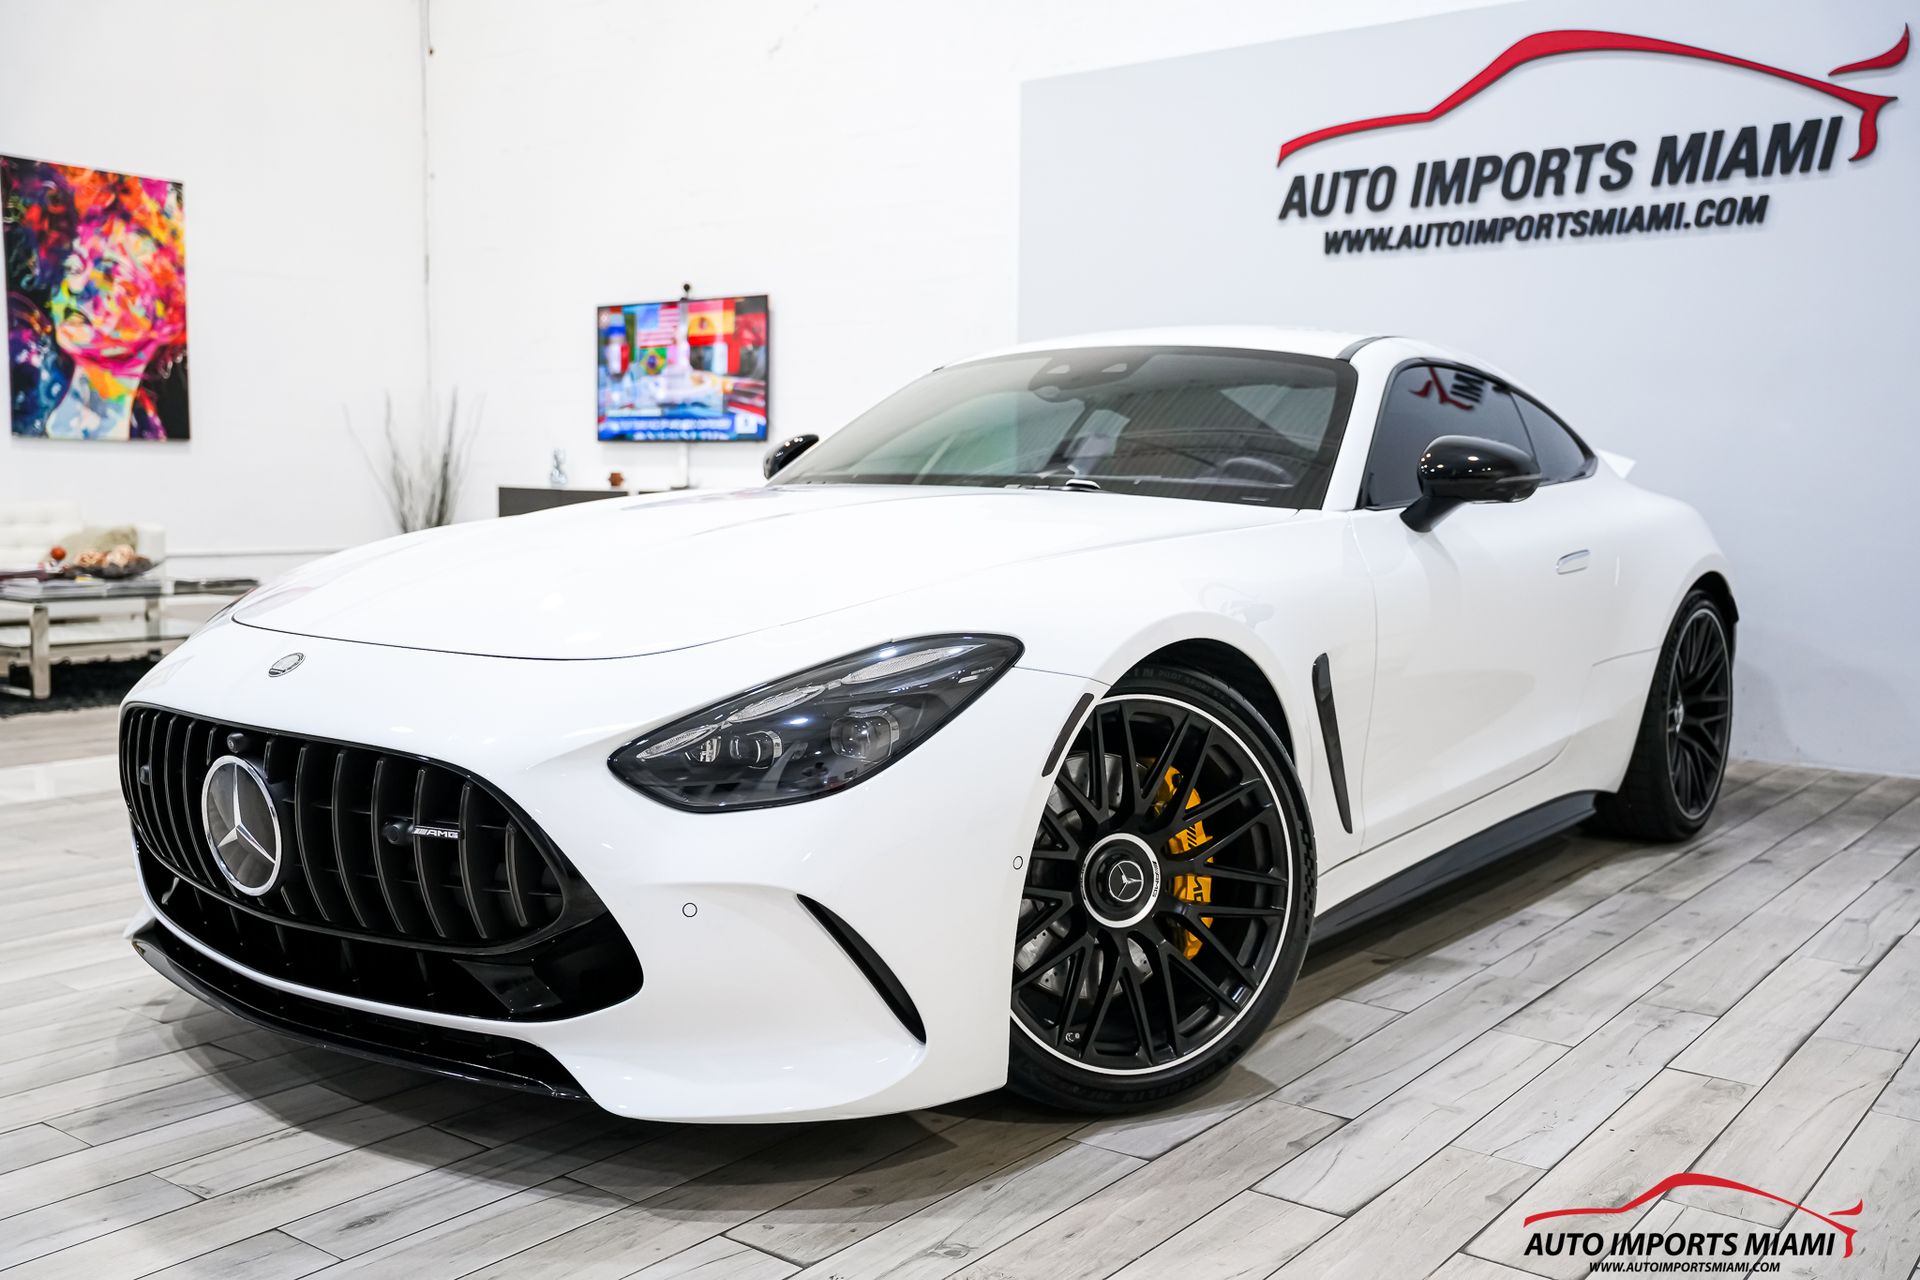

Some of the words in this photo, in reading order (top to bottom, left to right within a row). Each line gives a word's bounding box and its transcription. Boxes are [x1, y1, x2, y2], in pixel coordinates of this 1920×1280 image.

[1279, 166, 1397, 219] AUTO
[1410, 141, 1637, 209] IMPORTS
[1651, 116, 1844, 187] MIAMI
[1324, 195, 1770, 255] WWW.AUTOIMPORTSMIAMI.COM
[424, 828, 459, 839] AMG
